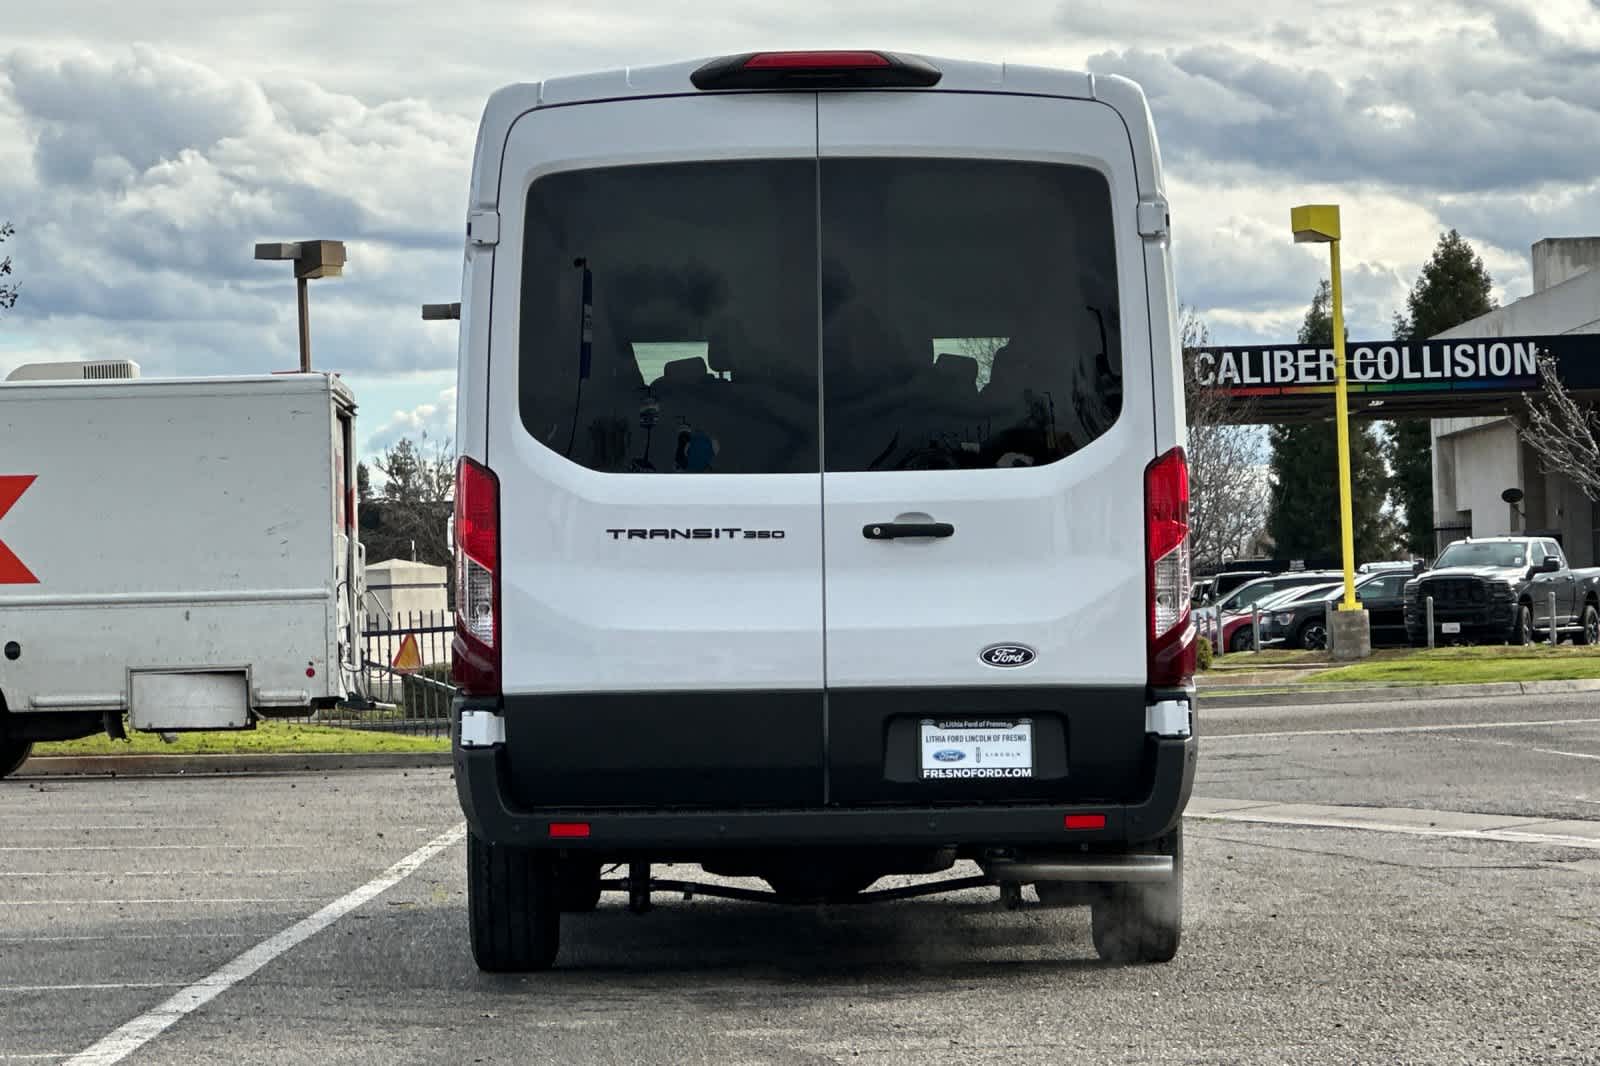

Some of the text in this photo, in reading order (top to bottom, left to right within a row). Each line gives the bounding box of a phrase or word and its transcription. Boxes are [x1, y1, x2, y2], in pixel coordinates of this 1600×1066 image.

[1194, 342, 1537, 385] CALIBER COLLISION
[606, 528, 742, 539] TRANSIT
[991, 648, 1025, 662] Ford
[925, 735, 946, 743] LITHIA
[965, 734, 992, 742] LINCOLN
[993, 734, 1001, 742] OF
[1002, 734, 1027, 742] FRESNO
[923, 768, 1032, 778] FRESNOFORD.COM
